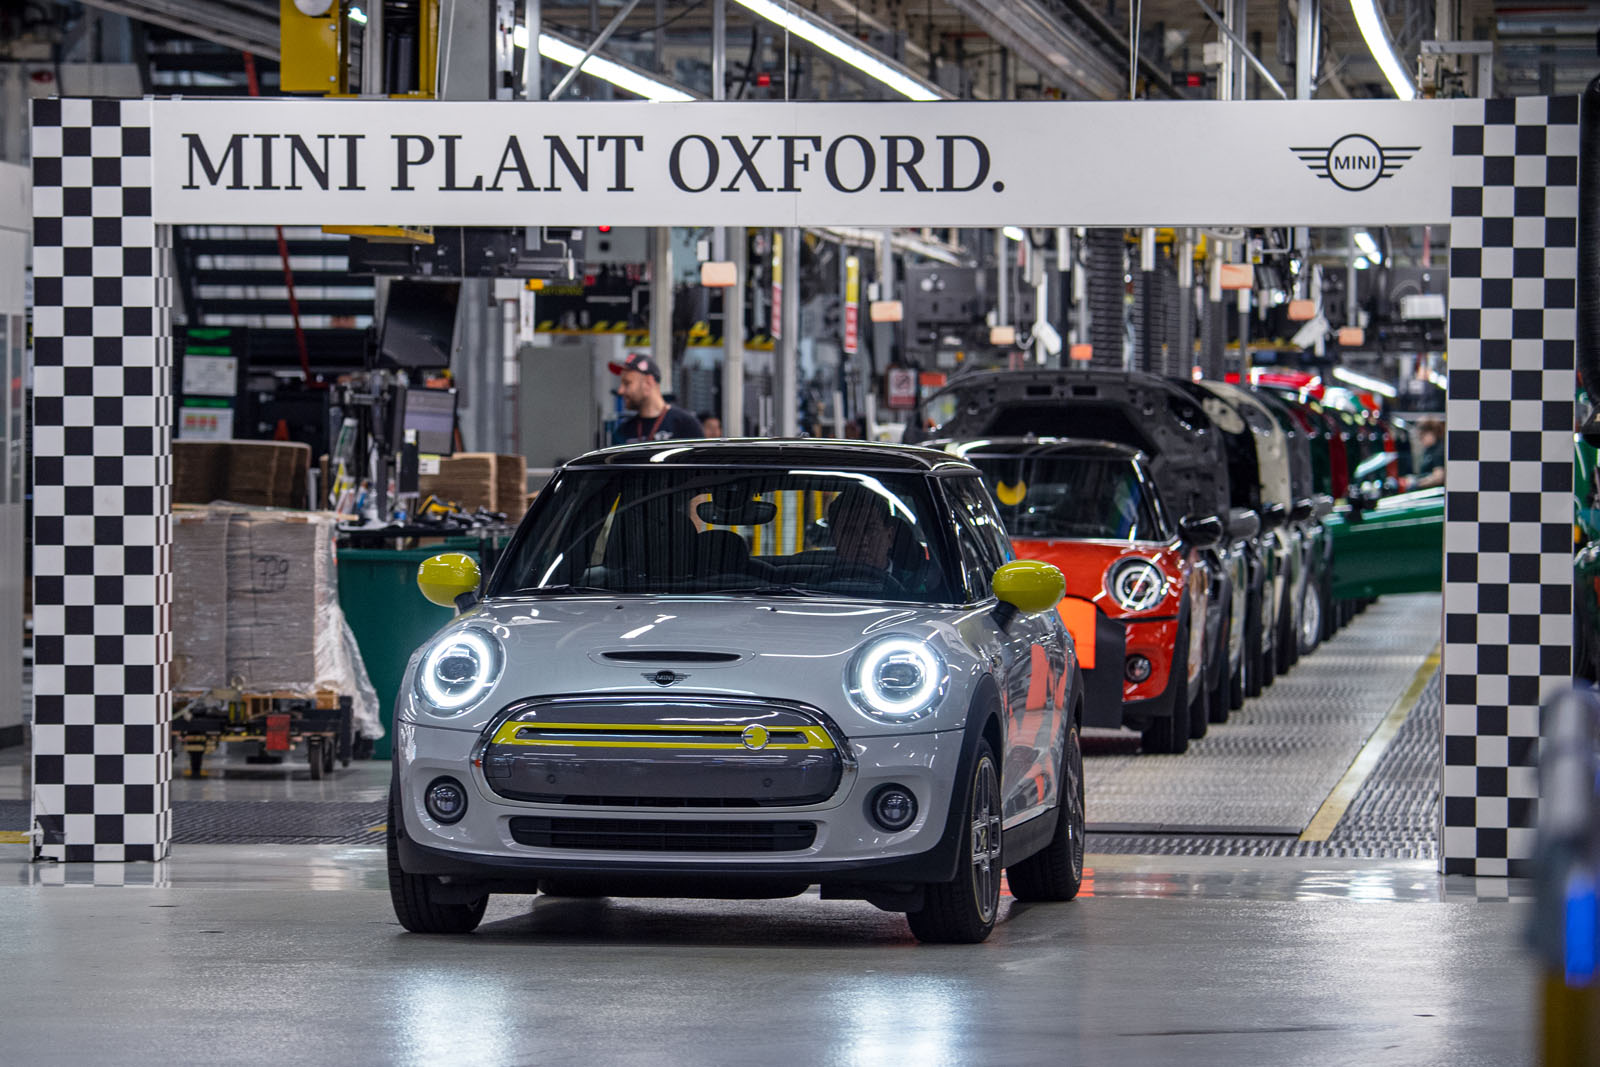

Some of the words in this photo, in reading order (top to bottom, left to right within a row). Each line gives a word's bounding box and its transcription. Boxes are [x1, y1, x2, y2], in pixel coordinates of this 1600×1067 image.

[181, 133, 366, 191] MINI
[390, 134, 644, 192] PLANT
[668, 134, 1005, 194] OXFORD.
[1334, 155, 1376, 169] MINI
